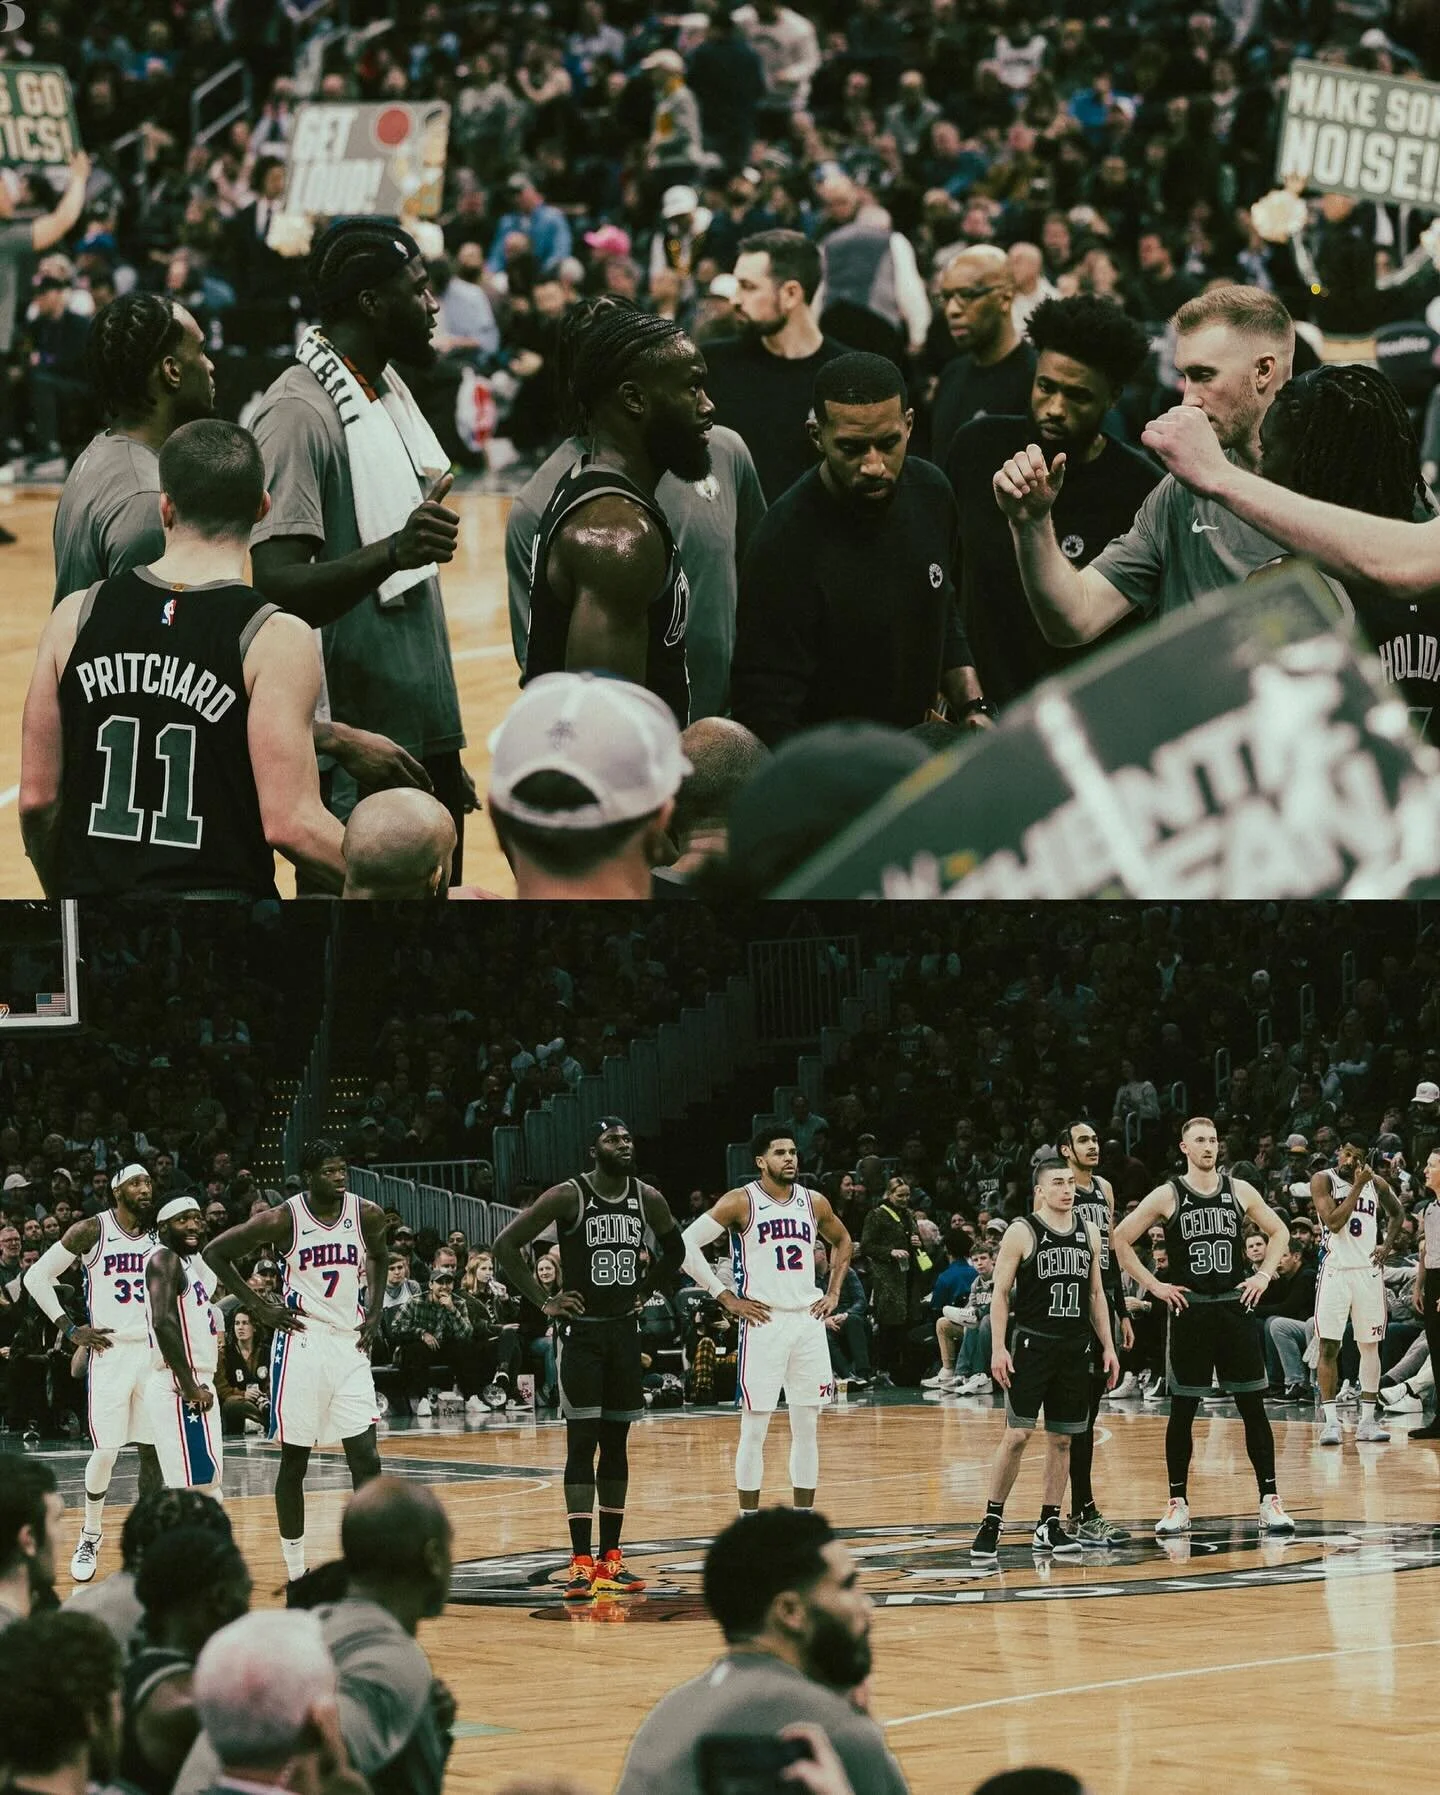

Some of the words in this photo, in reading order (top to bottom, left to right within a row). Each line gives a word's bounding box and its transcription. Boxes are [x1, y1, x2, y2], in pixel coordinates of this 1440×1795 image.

[16, 71, 68, 117] GO
[1287, 71, 1382, 128] MAKE
[1379, 633, 1440, 688] HOLID
[76, 653, 236, 723] PRITCHARD
[88, 715, 203, 849] 11
[585, 1213, 641, 1247] CELTICS
[757, 1218, 812, 1244] PHILA
[1180, 1207, 1237, 1240] CELTICS
[1349, 1218, 1362, 1237] 8
[298, 1243, 359, 1271] PHILA
[591, 1249, 637, 1286] 88
[775, 1244, 804, 1271] 12
[1036, 1246, 1091, 1279] CELTICS
[1189, 1240, 1233, 1275] 30
[322, 1270, 340, 1298] 7
[1048, 1282, 1080, 1317] 11
